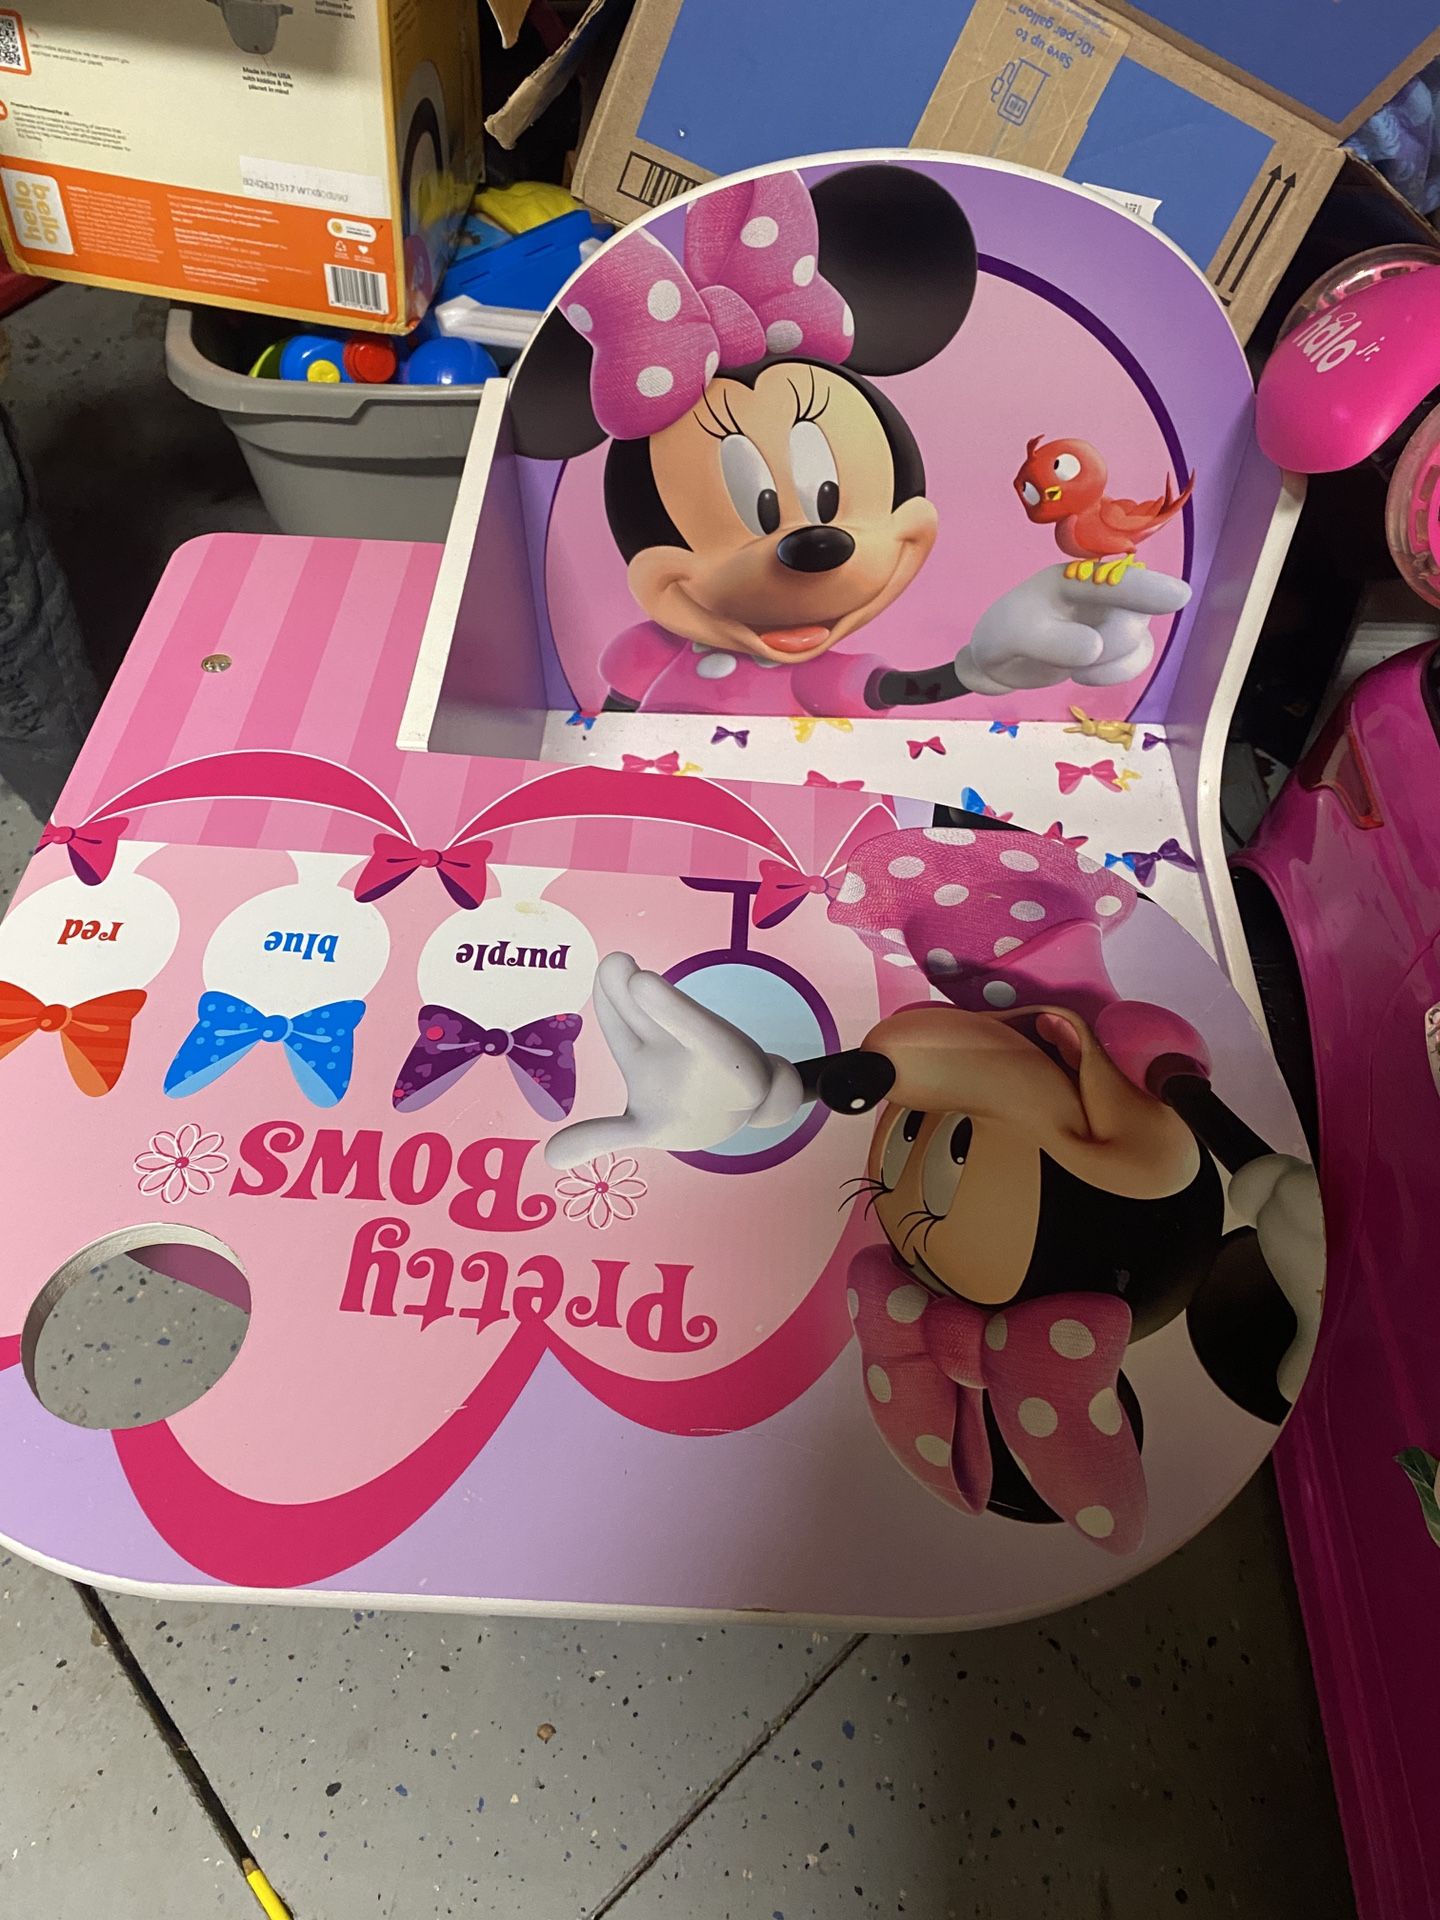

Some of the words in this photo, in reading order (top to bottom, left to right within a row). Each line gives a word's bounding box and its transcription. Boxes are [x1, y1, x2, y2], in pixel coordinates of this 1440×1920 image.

[1015, 27, 1028, 42] to
[1031, 34, 1045, 49] up
[1053, 26, 1077, 42] per
[1046, 45, 1073, 69] Save
[15, 181, 42, 241] hello
[58, 919, 123, 945] red
[264, 931, 339, 963] blue
[456, 941, 570, 971] purple
[339, 1217, 718, 1354] Pretty
